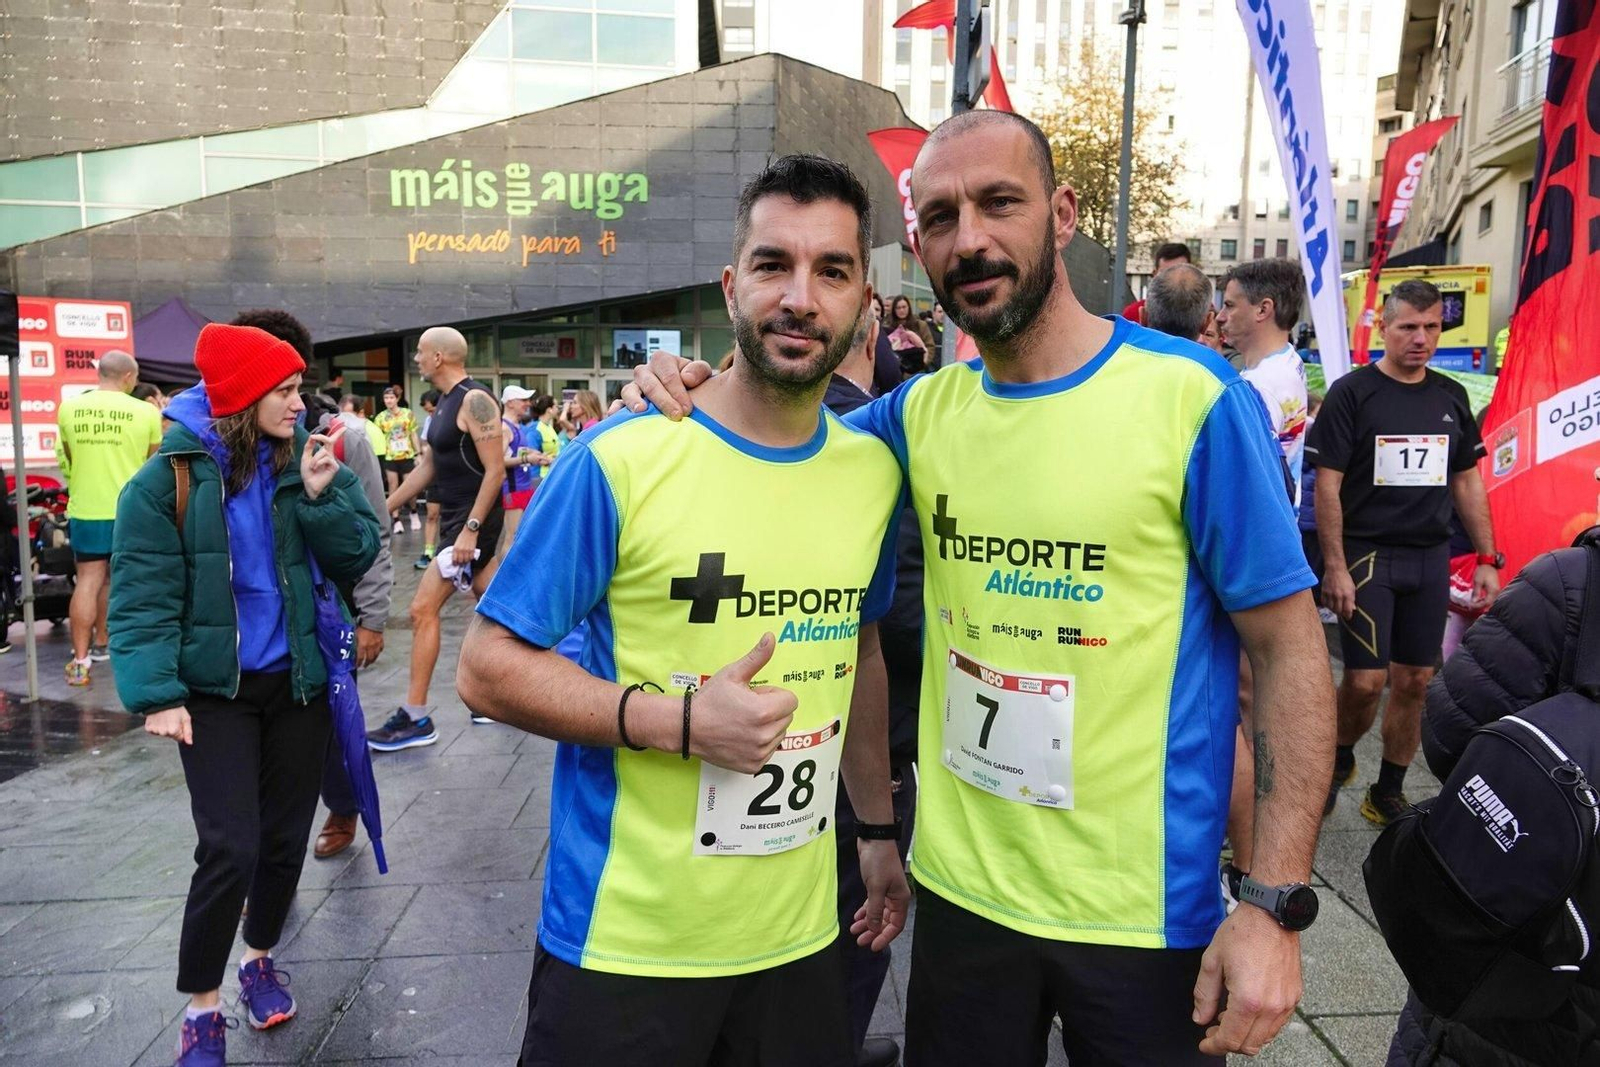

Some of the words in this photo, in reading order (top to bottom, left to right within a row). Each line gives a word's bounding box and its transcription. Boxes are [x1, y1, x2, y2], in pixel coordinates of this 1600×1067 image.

[390, 158, 499, 209] máis
[505, 162, 538, 216] que
[540, 170, 649, 220] auga
[408, 229, 511, 264] pensado
[520, 234, 581, 267] para
[598, 230, 617, 256] ti
[64, 349, 95, 360] RUN
[109, 409, 134, 422] que
[74, 423, 89, 434] un
[93, 421, 122, 436] plan
[1399, 447, 1429, 469] 17
[953, 533, 1107, 572] DEPORTE
[984, 568, 1104, 602] Atlántico
[992, 622, 1013, 636] máis
[1020, 627, 1043, 641] auga
[1058, 626, 1081, 637] RUN
[672, 674, 698, 682] CONCELLO
[783, 670, 803, 683] máis
[976, 692, 1000, 750] 7
[971, 752, 993, 767] FONTAN
[993, 762, 1024, 776] GARRIDO
[747, 759, 817, 816] 28
[1465, 774, 1515, 828] PUMA
[757, 820, 786, 830] BECEIRO
[786, 811, 815, 826] CAMESELLE
[1480, 810, 1492, 823] MIT
